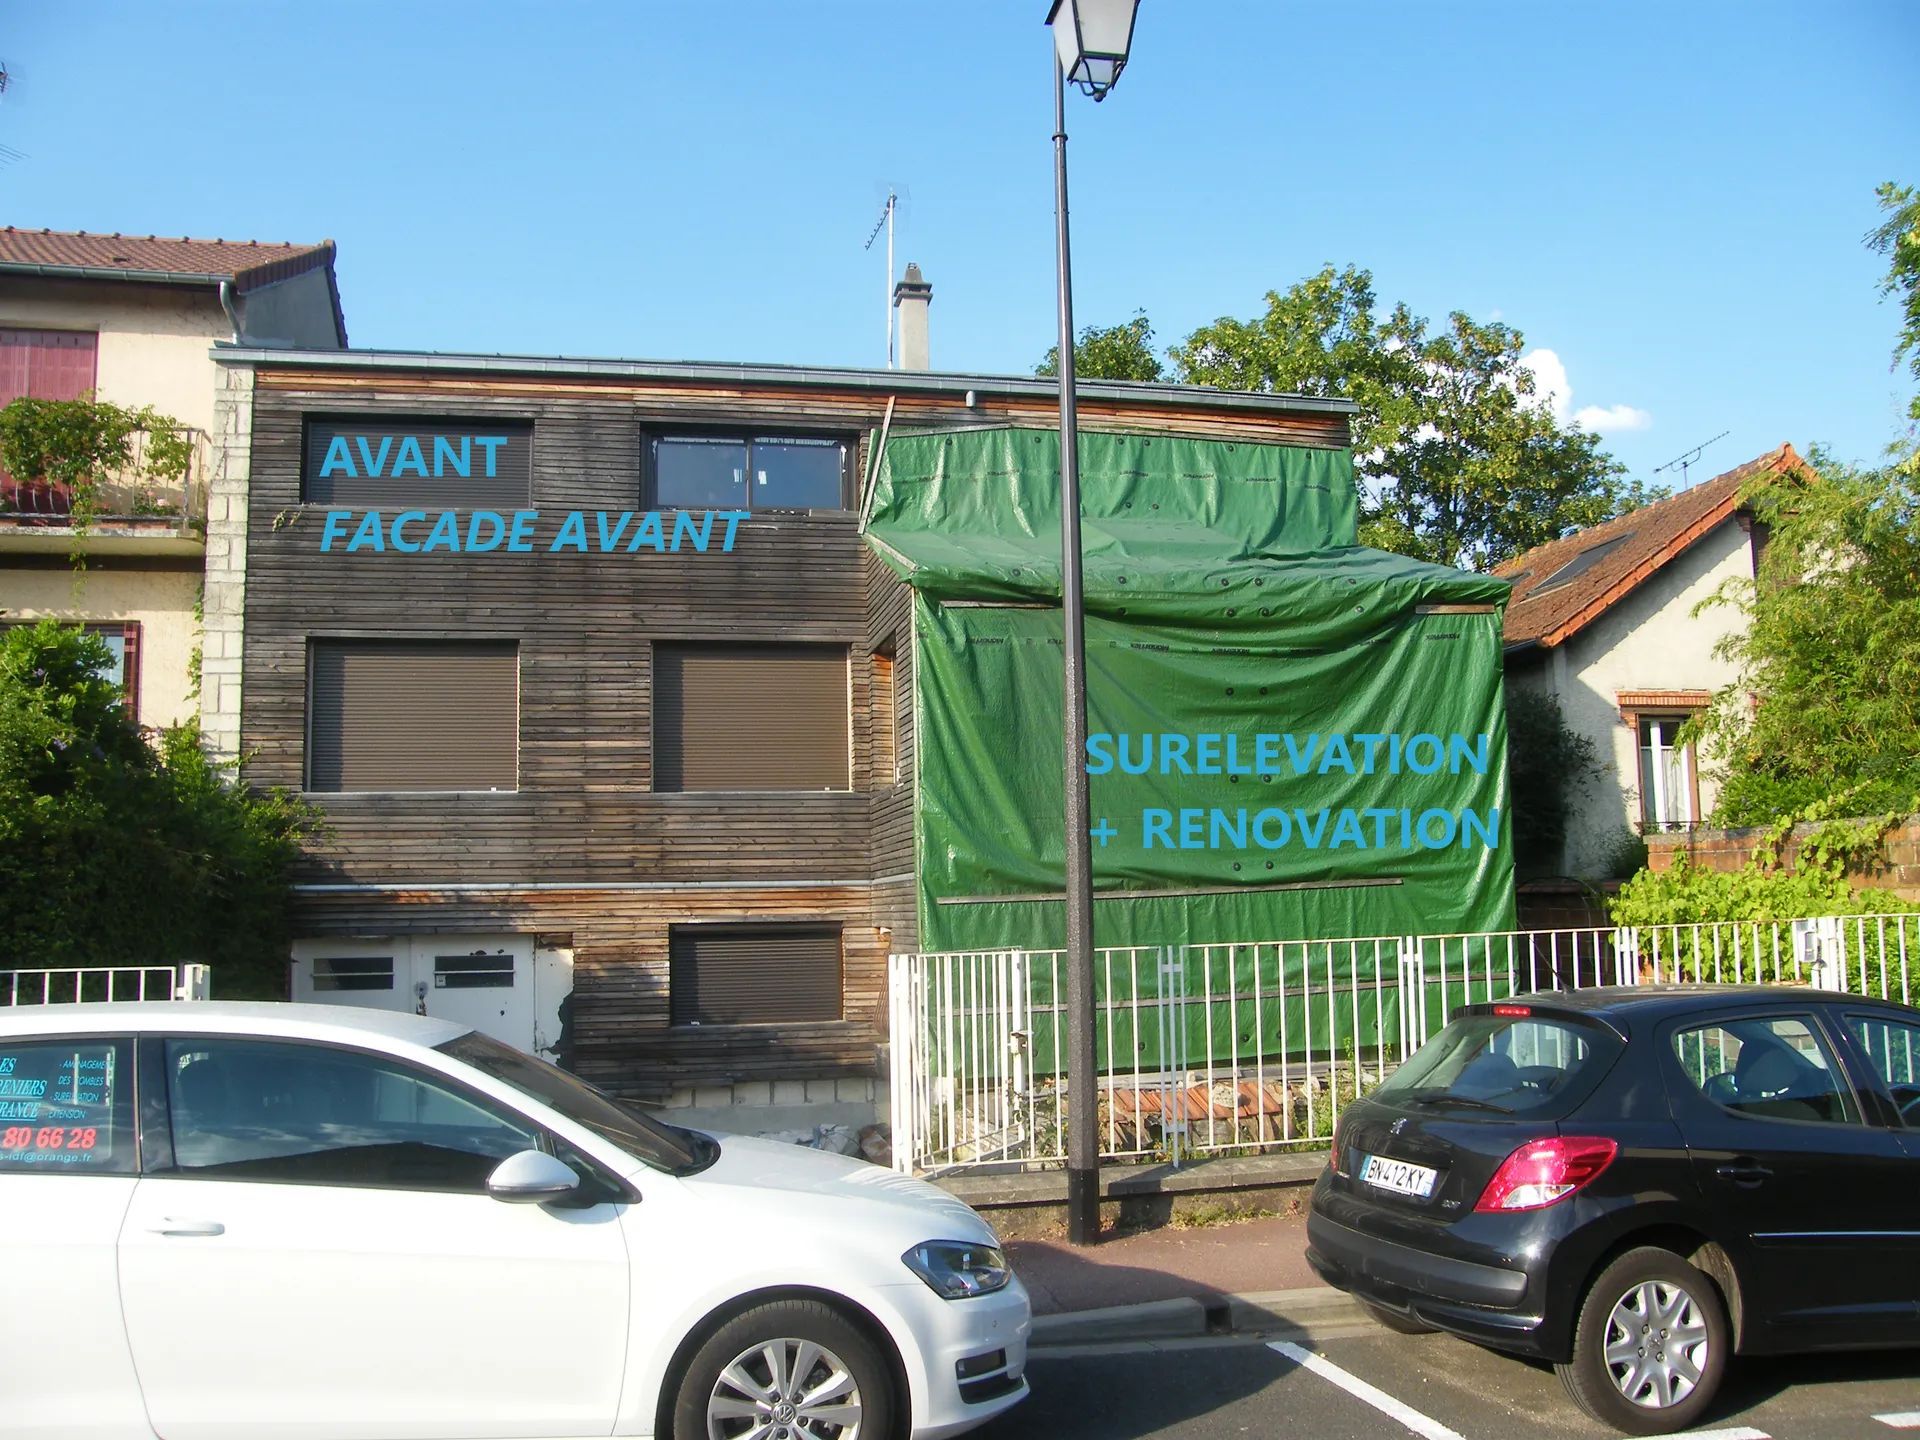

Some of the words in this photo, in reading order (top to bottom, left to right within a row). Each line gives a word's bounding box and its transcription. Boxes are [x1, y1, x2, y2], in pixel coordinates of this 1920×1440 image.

[0, 1057, 17, 1073] ES
[0, 1080, 47, 1096] ENIERS
[0, 1101, 40, 1118] RANCE
[3, 1127, 32, 1149] 80
[36, 1128, 64, 1149] 66
[67, 1128, 97, 1149] 28
